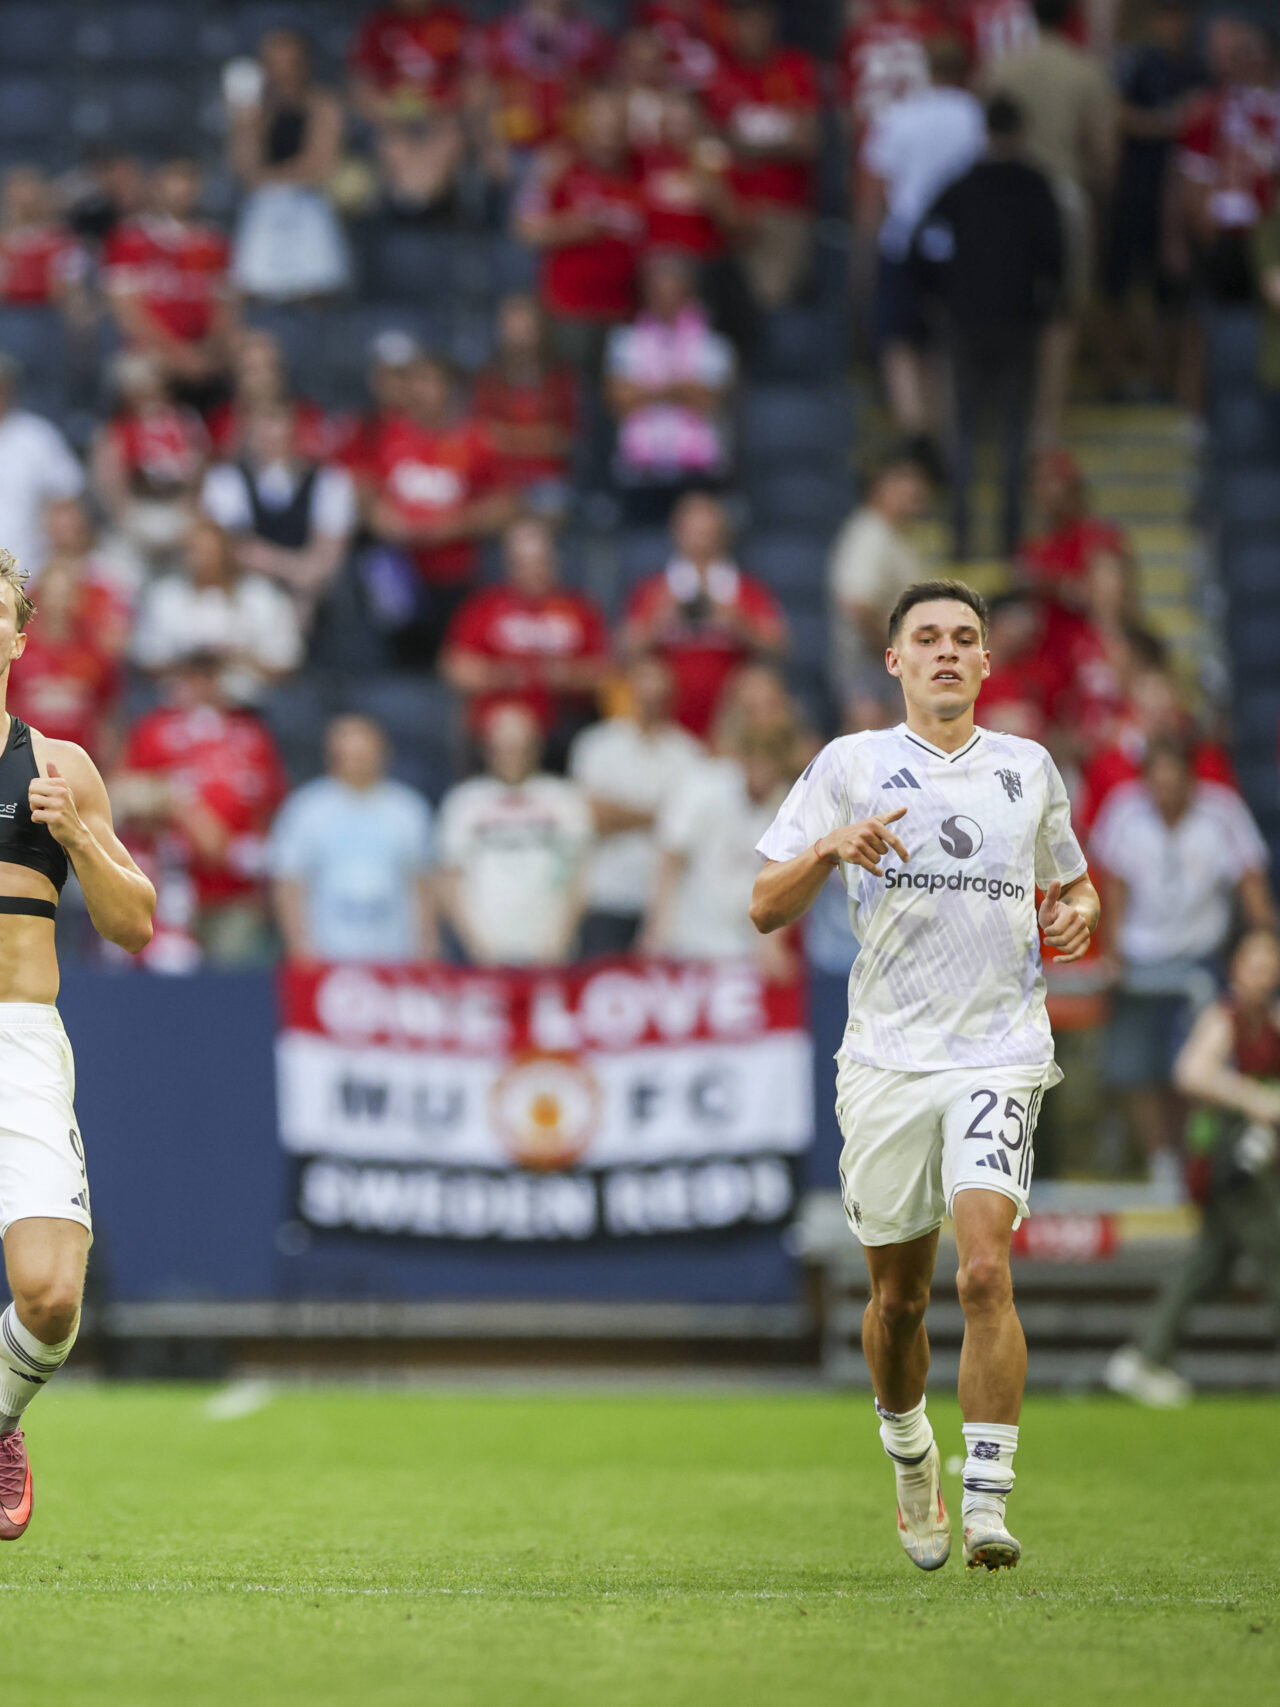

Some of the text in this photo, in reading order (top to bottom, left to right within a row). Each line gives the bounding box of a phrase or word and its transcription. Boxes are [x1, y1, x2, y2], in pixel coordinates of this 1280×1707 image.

[884, 867, 1025, 901] Snapdragon
[317, 963, 766, 1050] ONE LOVE
[964, 1089, 1026, 1150] 25
